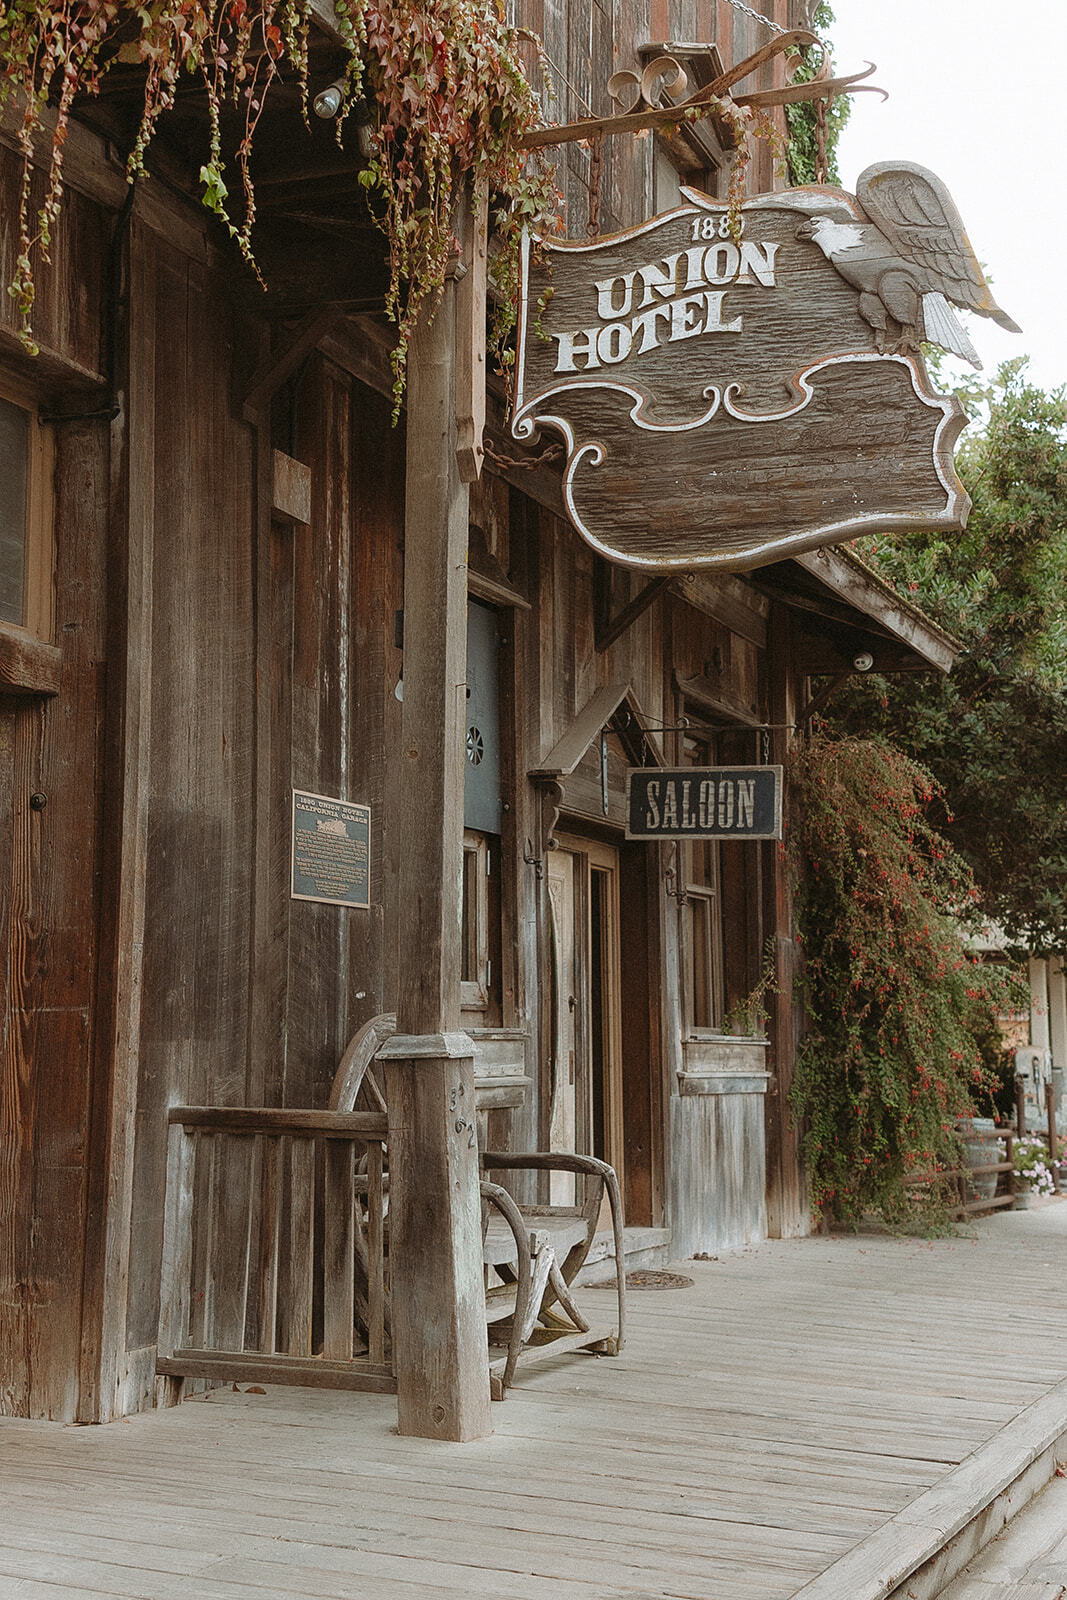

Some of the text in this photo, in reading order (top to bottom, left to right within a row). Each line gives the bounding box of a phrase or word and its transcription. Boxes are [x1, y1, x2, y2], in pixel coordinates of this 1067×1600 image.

[594, 241, 781, 320] UNION
[551, 291, 742, 372] HOTEL
[296, 803, 339, 818] CALIFORNIA
[318, 802, 340, 811] UNION
[342, 808, 364, 817] HOTEL
[646, 779, 756, 829] SALOON
